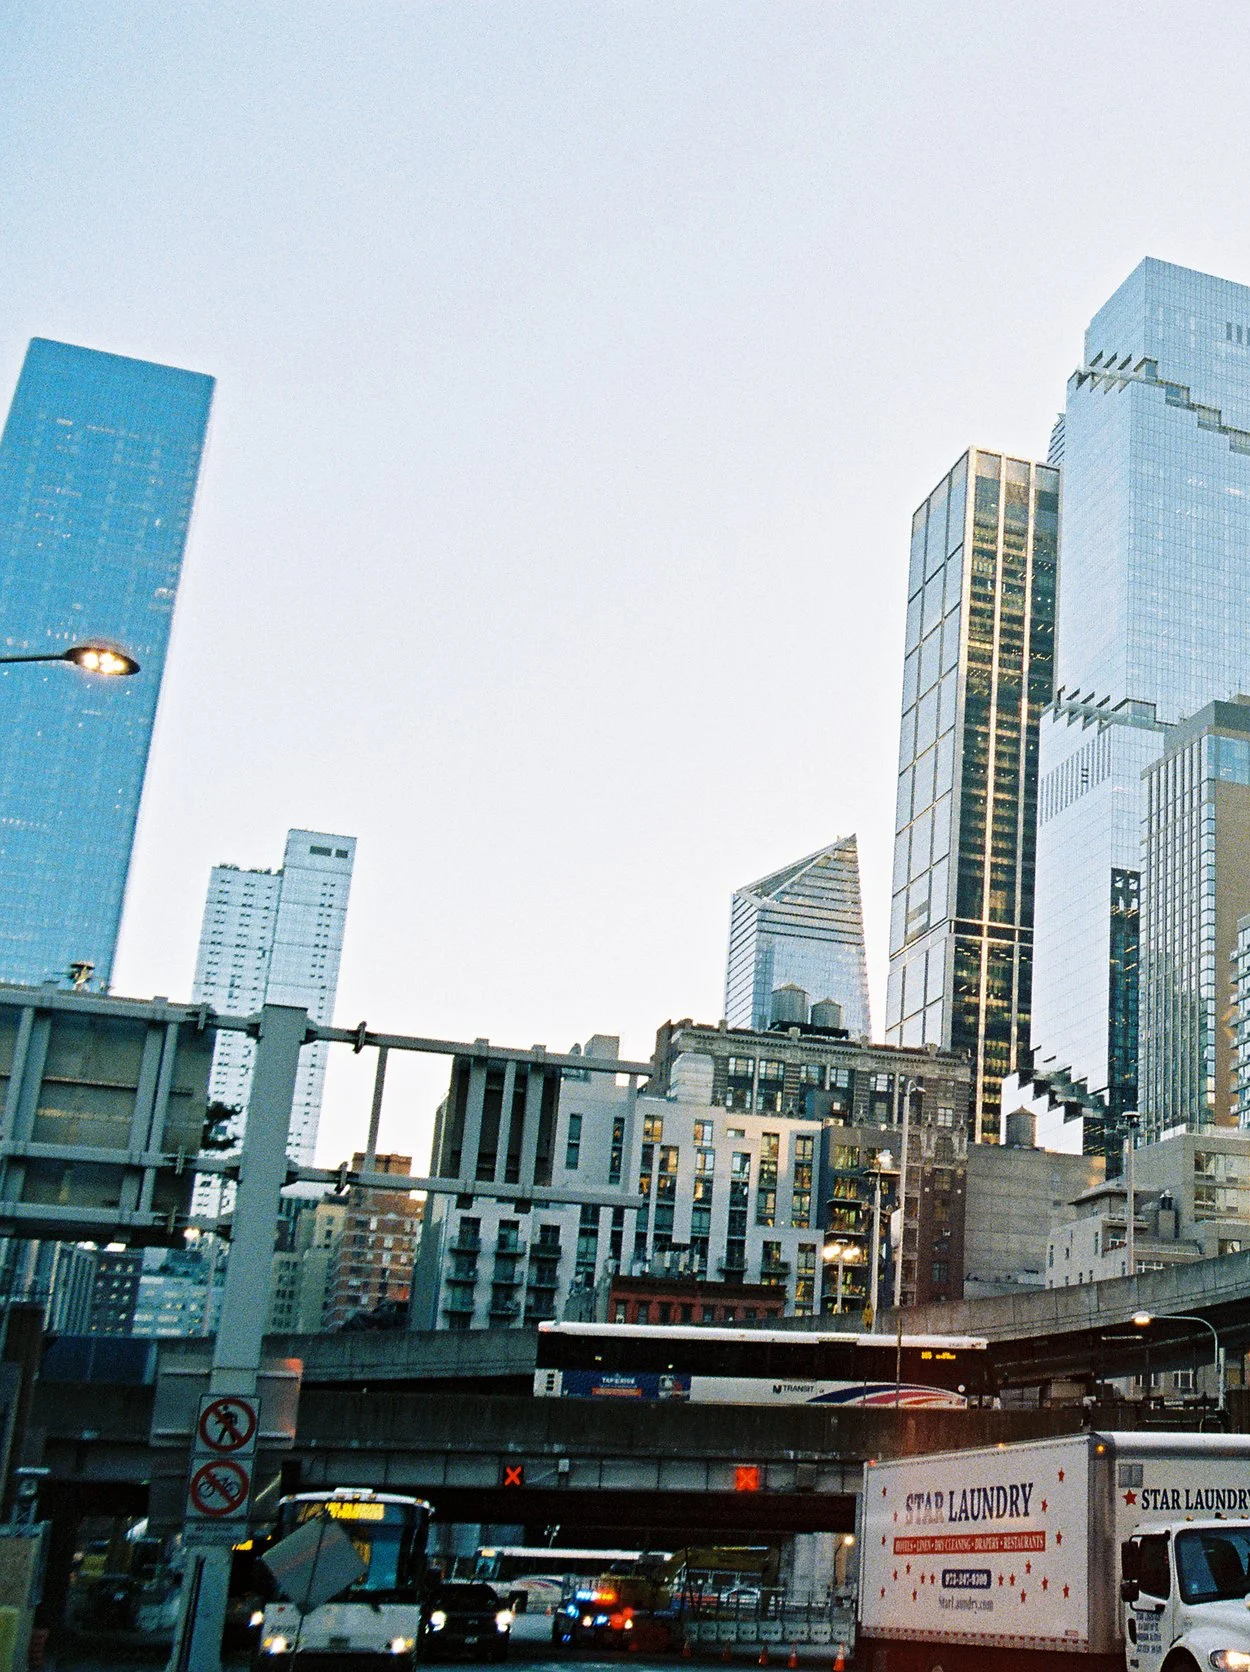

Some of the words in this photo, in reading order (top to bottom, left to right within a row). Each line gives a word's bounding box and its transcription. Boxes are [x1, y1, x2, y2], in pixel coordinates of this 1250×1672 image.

[905, 1491, 944, 1525] STAR
[948, 1482, 1033, 1522] LAUNDRY
[1141, 1488, 1181, 1510] STAR
[974, 1537, 1000, 1549] DRAPERY
[1003, 1535, 1044, 1549] RESTAURANTS
